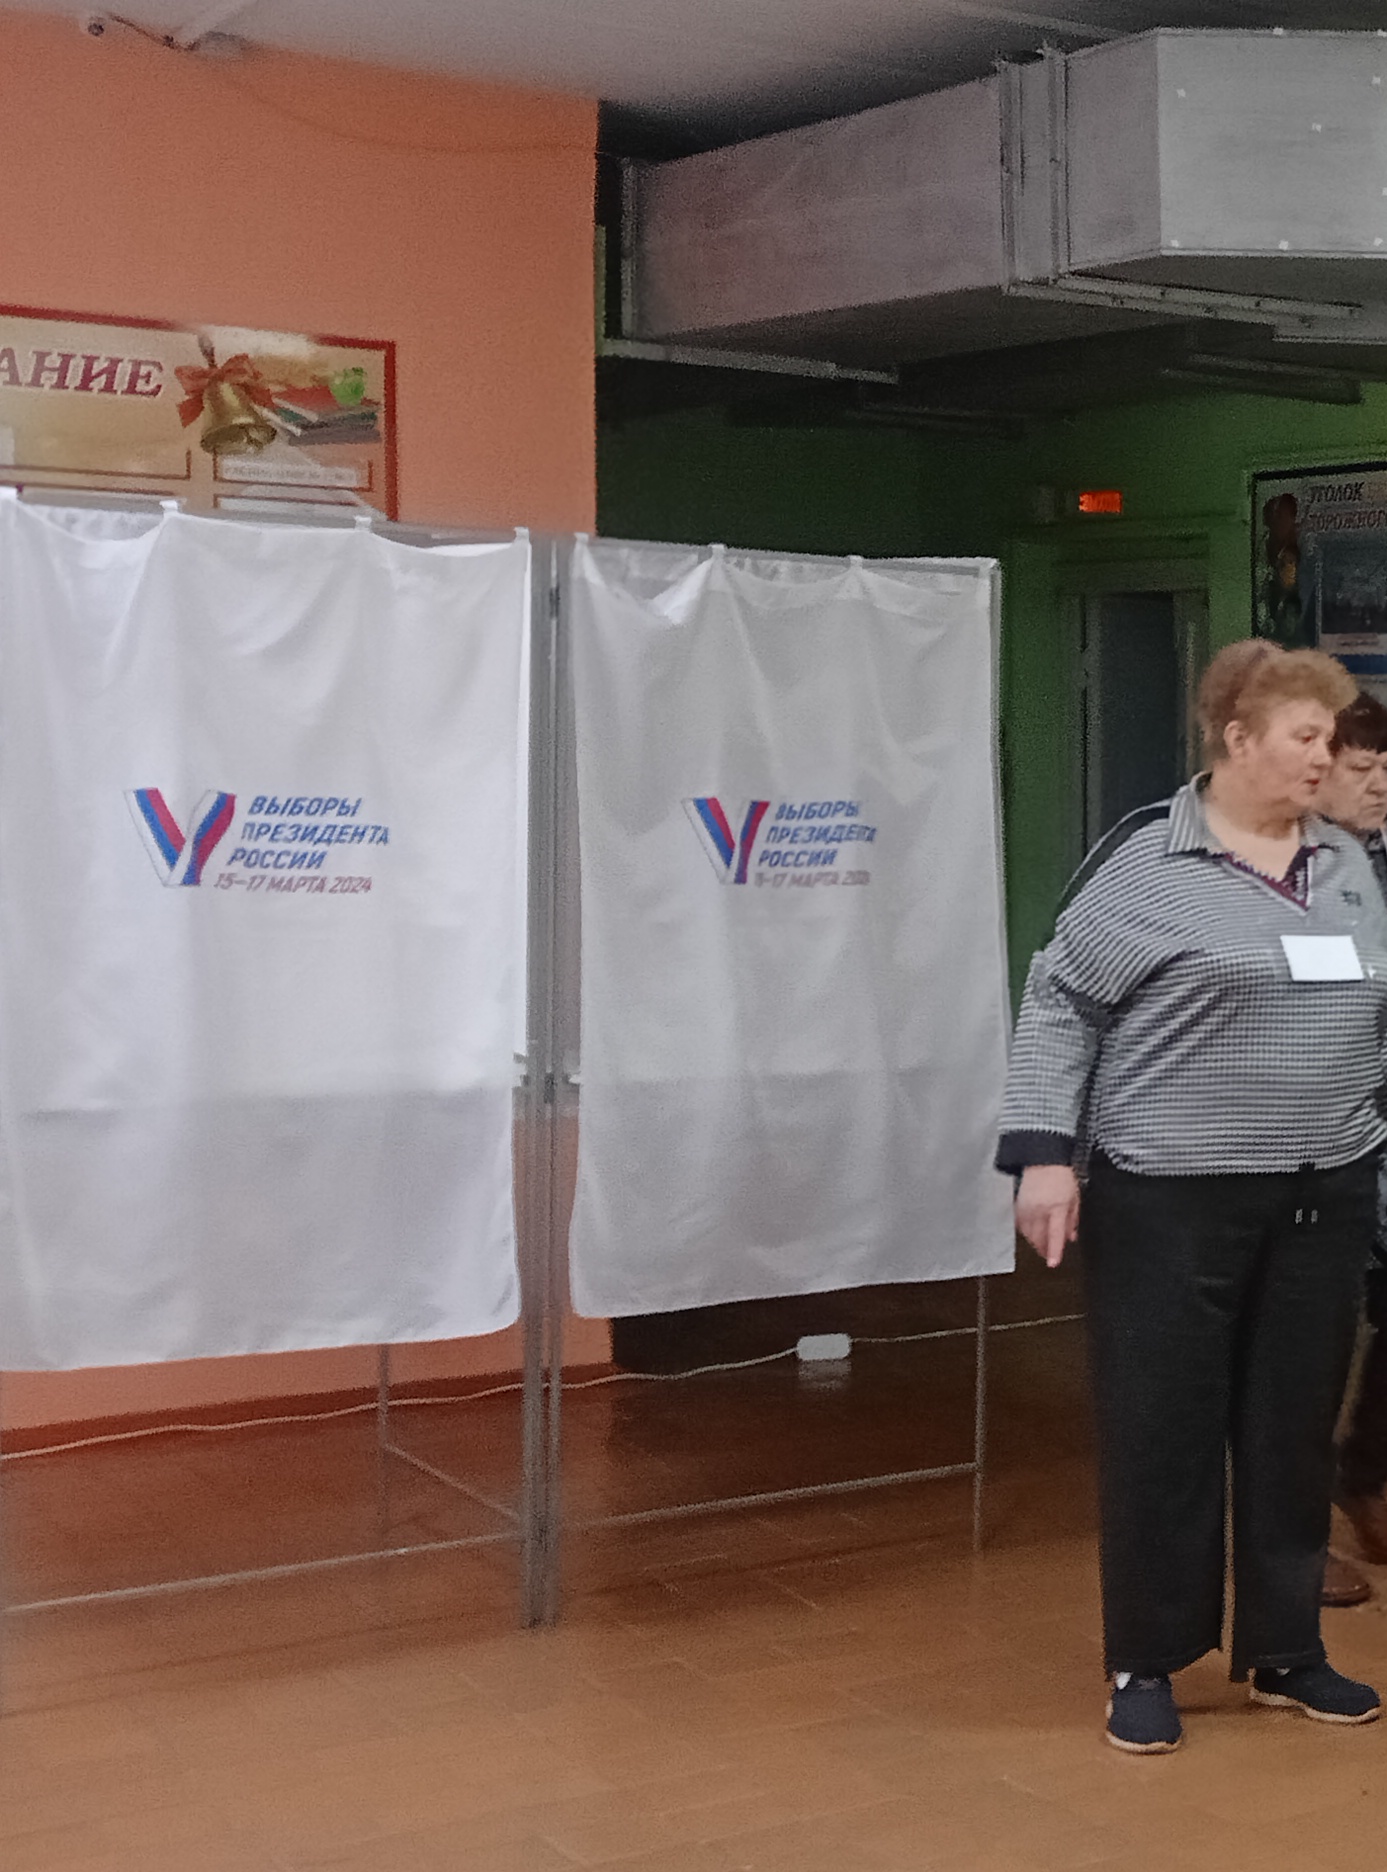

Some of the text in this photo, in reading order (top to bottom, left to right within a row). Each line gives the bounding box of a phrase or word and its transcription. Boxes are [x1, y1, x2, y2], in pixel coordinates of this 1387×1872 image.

[248, 795, 362, 818] ВЫБОРЫ
[241, 822, 390, 846] ПРЕЗИДЕНТА
[227, 848, 328, 870] РОССИИ
[758, 848, 838, 868] РОССИИ
[267, 876, 326, 894] МАРТА
[329, 875, 373, 894] 2024
